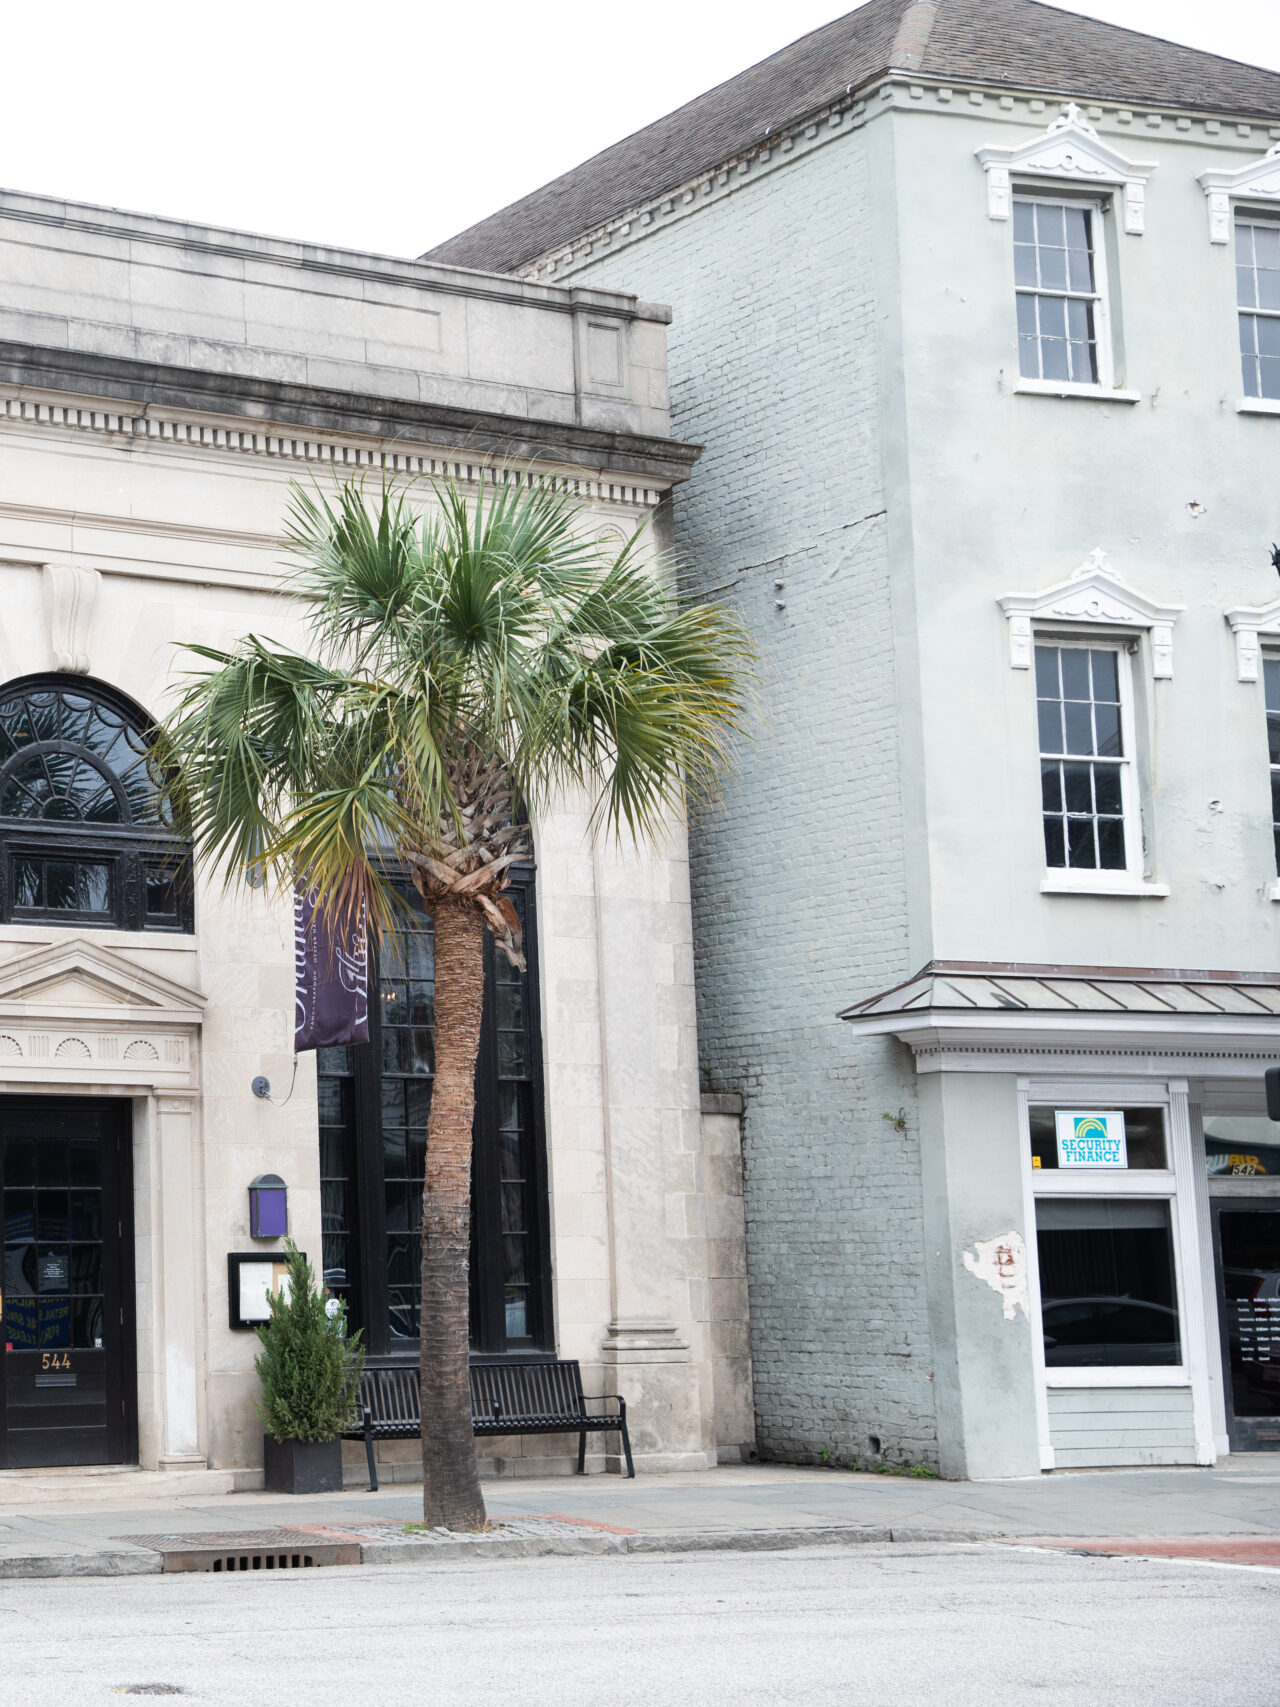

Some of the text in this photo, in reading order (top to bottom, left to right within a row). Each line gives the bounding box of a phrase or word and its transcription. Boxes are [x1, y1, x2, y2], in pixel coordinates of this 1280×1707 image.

[1061, 1139, 1121, 1151] SECURITY
[1066, 1151, 1120, 1162] FINANCE
[1233, 1163, 1255, 1175] 542
[42, 1353, 71, 1370] 544
